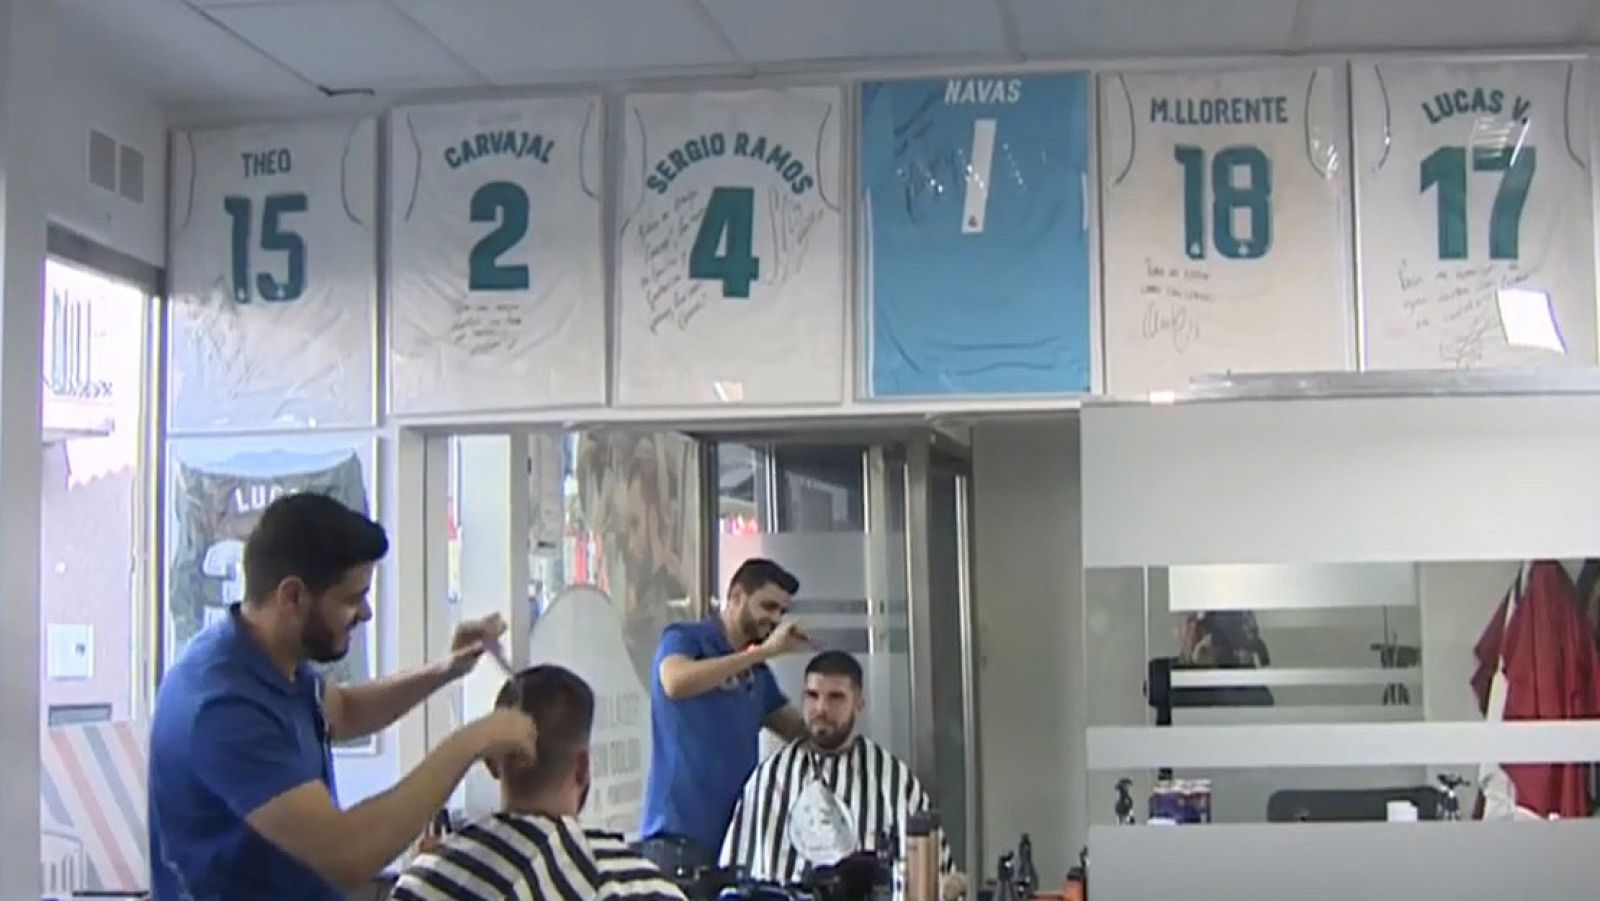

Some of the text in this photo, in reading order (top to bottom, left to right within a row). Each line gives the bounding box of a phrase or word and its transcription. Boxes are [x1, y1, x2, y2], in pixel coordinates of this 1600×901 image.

[944, 78, 1022, 105] NAVAS
[1150, 96, 1289, 125] M.LLORENTE
[1422, 87, 1531, 124] LUCAS V.
[241, 148, 292, 178] THEO
[444, 131, 554, 169] CARVAJAL
[646, 132, 814, 194] SERGIO RAMOS
[961, 118, 997, 235] 1
[468, 180, 530, 291] 2
[688, 185, 760, 299] 4
[1173, 143, 1273, 260] 18
[1418, 144, 1537, 260] 17
[223, 192, 308, 304] 15
